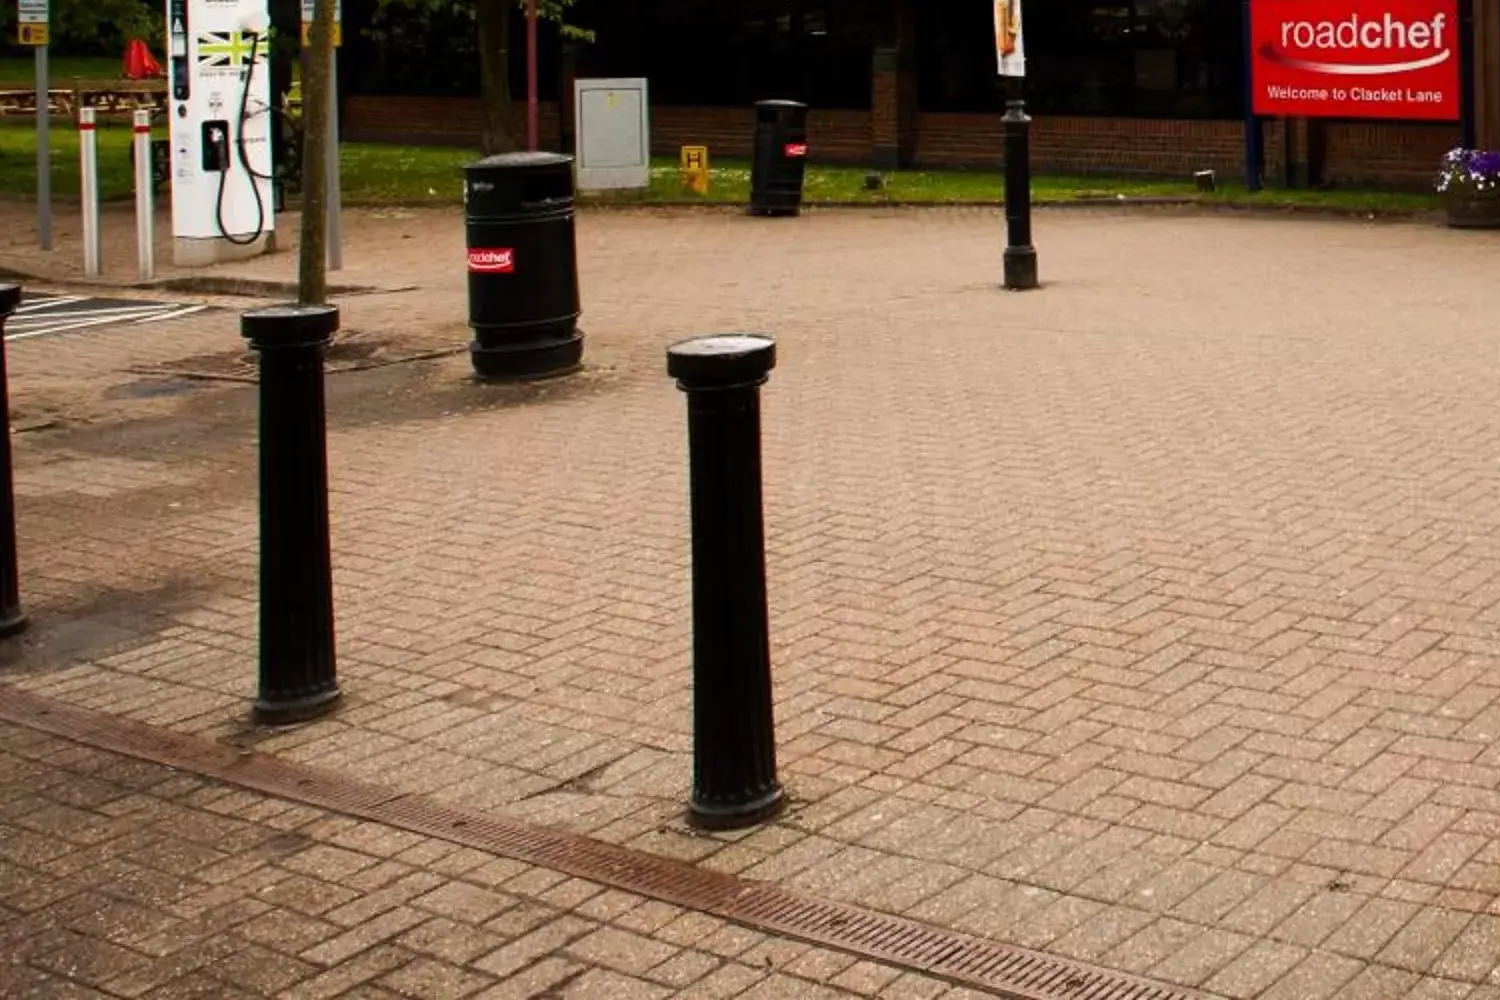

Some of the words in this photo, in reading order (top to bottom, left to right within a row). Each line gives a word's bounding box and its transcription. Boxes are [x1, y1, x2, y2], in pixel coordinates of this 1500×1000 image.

[1281, 13, 1446, 49] roadchef
[1267, 85, 1328, 101] Welcome
[1332, 86, 1346, 101] to
[1350, 87, 1403, 102] Clacket
[1407, 88, 1443, 103] Lane
